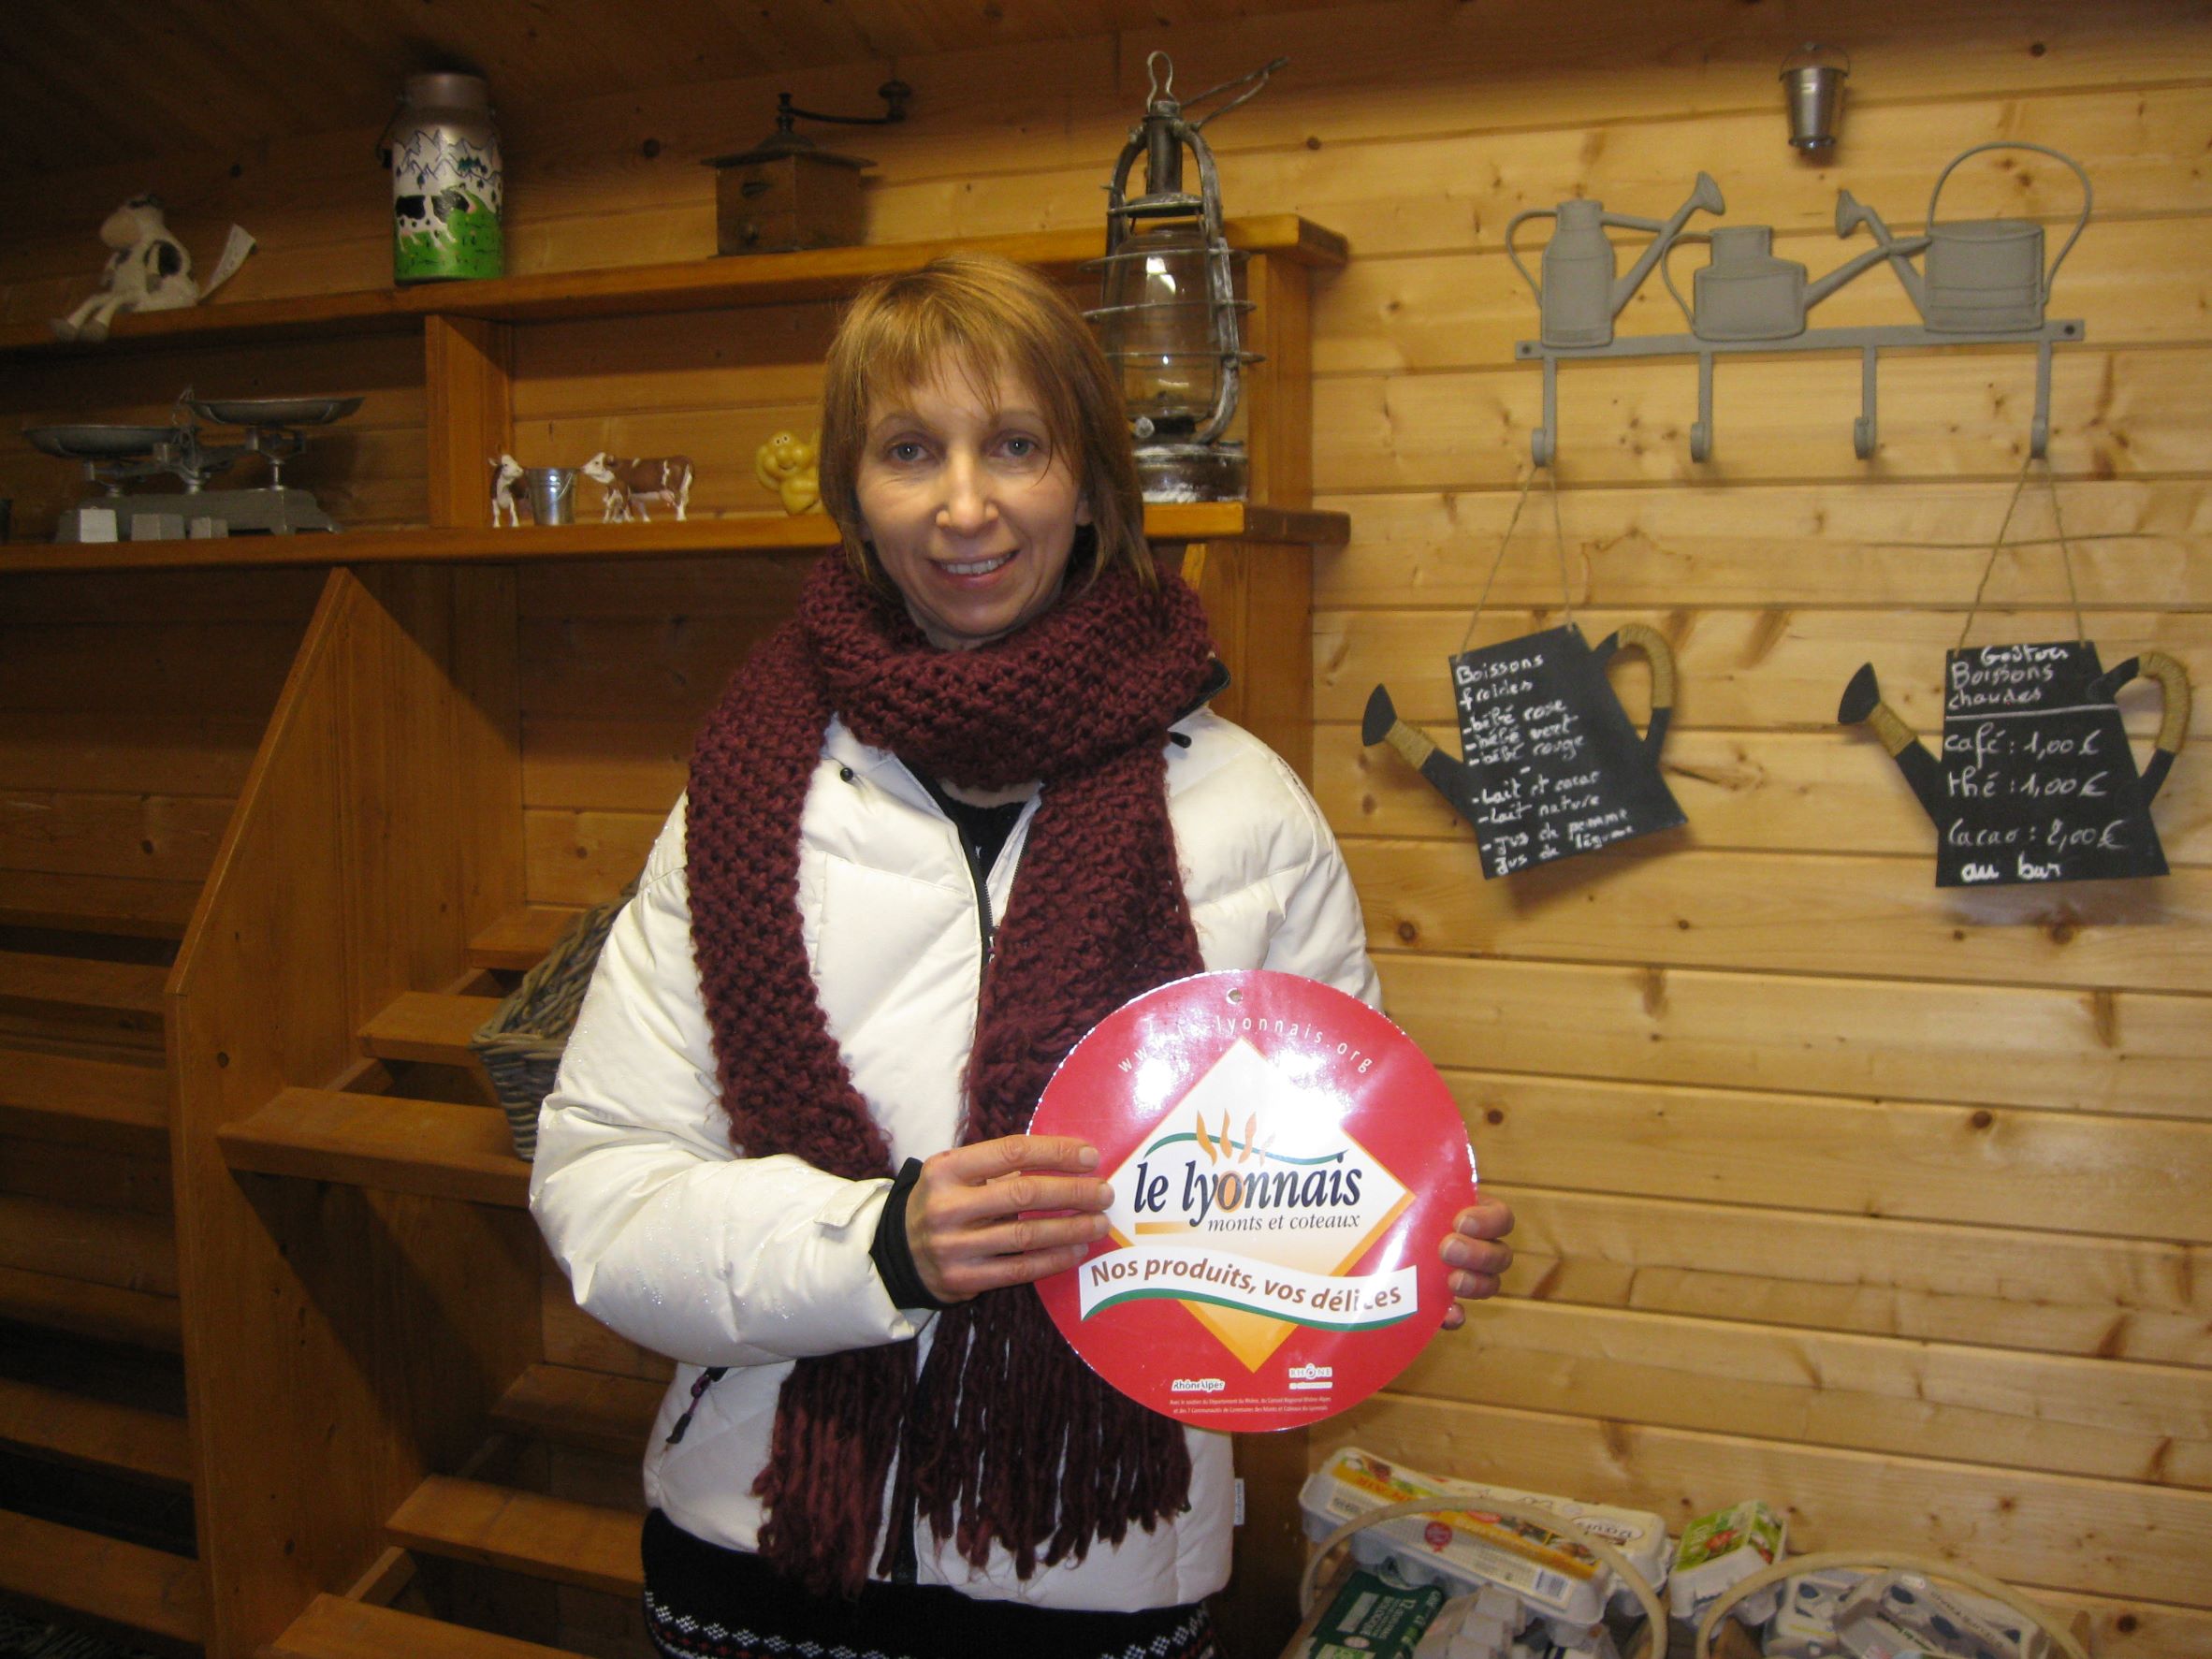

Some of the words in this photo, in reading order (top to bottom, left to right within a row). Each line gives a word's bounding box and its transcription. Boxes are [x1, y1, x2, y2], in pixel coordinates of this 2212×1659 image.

[1456, 654, 1544, 685] Boissons
[1134, 1160, 1169, 1214] le
[1182, 1152, 1362, 1227] lyonnais
[1208, 1217, 1262, 1232] monts
[1269, 1215, 1284, 1230] et
[1290, 1215, 1361, 1229] coteaux
[1091, 1259, 1138, 1287] Nos
[1144, 1258, 1257, 1293] produits,
[1264, 1278, 1304, 1303] vos
